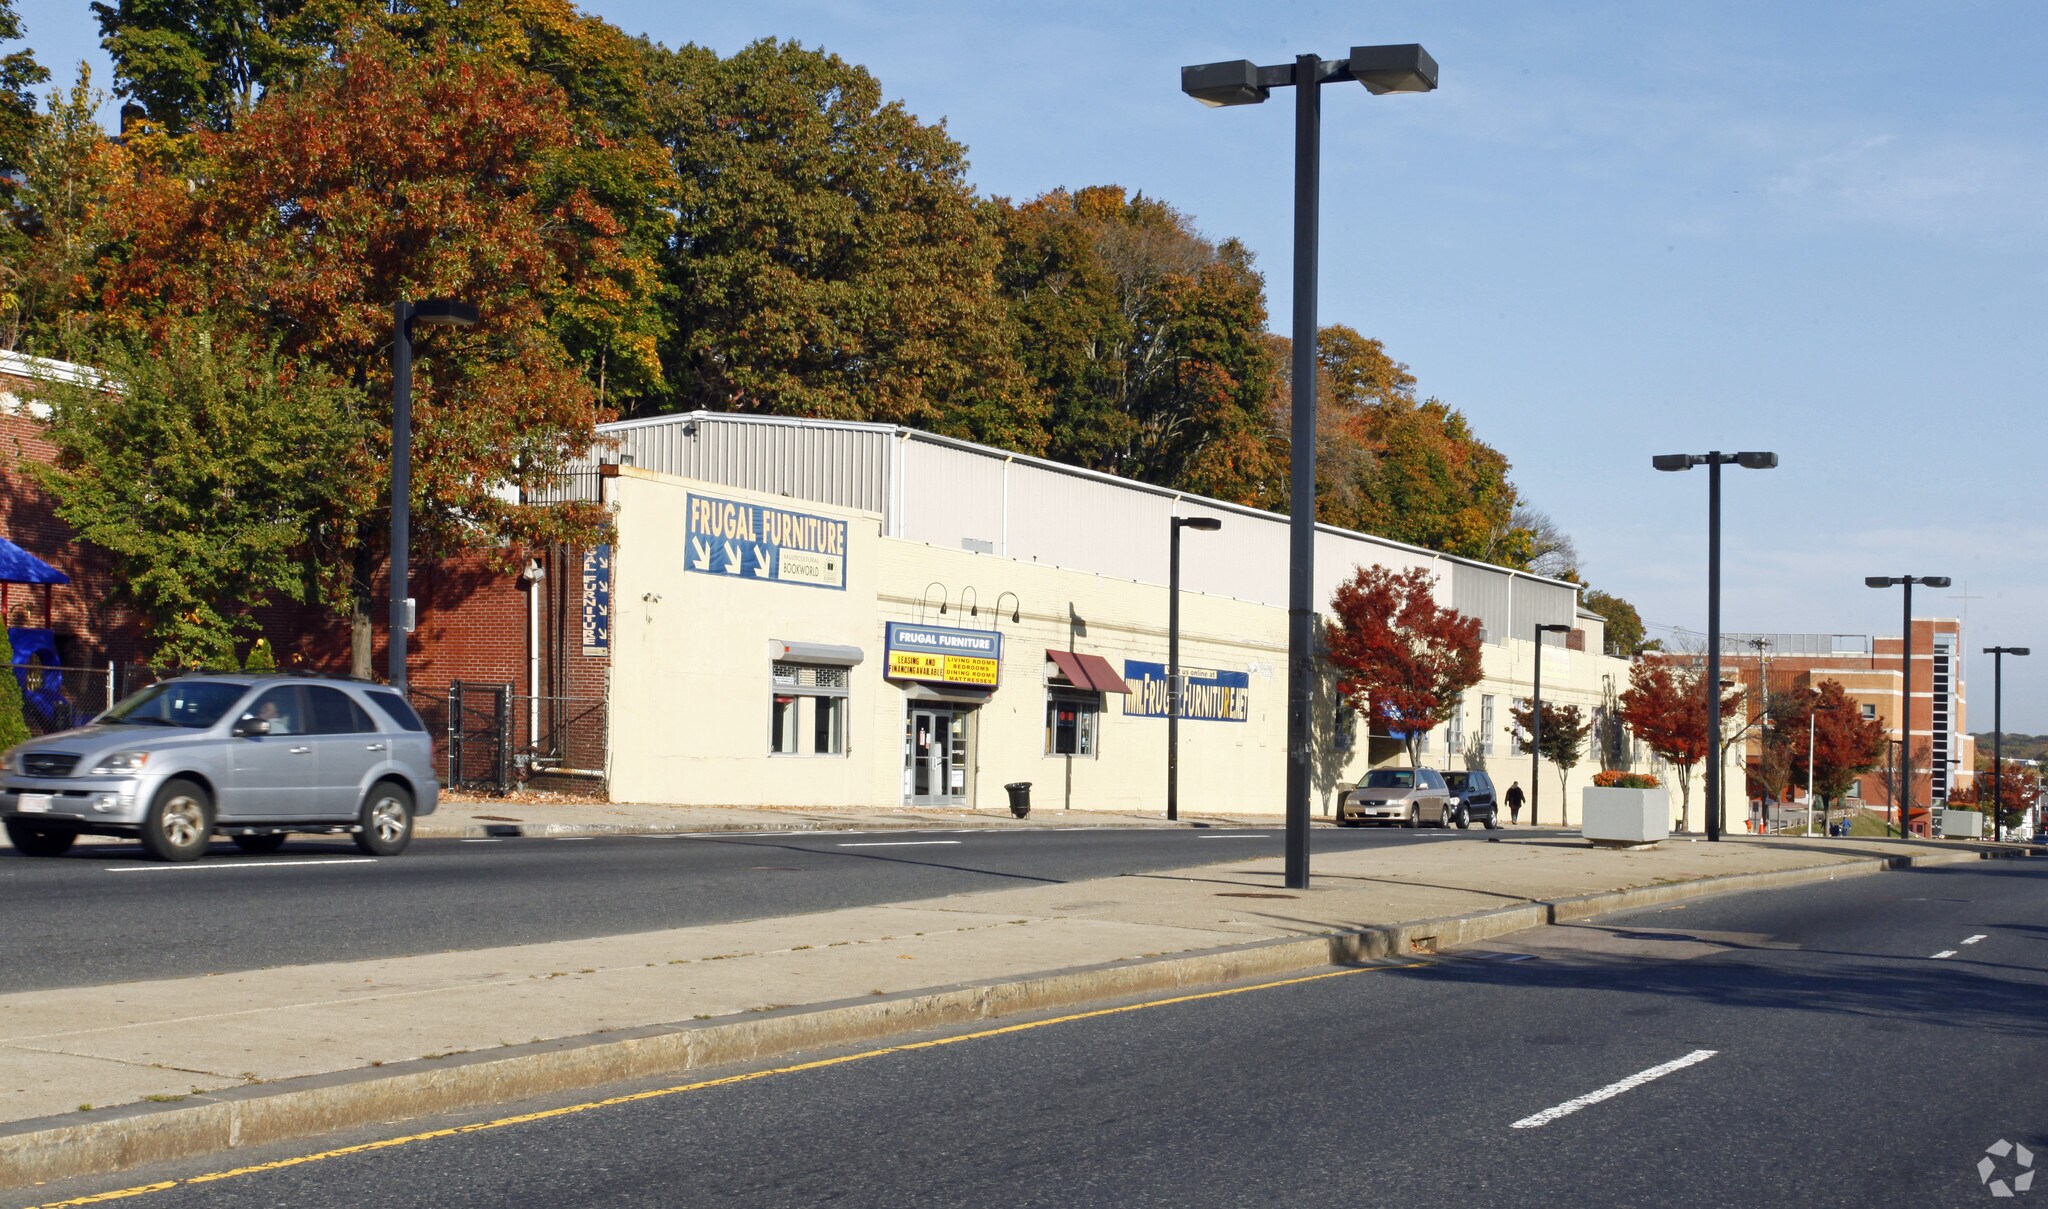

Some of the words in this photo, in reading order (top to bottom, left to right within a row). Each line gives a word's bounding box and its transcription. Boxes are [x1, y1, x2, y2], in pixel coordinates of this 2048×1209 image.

[691, 497, 757, 542] FRUGAL
[763, 510, 844, 556] FURNITURE
[783, 563, 820, 577] BOOKWORLD
[583, 575, 597, 645] FURNITURE
[899, 632, 937, 645] FRUGAL
[939, 635, 991, 649] FURNITURE
[897, 656, 920, 665] LEASING
[925, 658, 936, 666] AND
[949, 676, 992, 684] MATTRESSES
[1190, 669, 1209, 677] online
